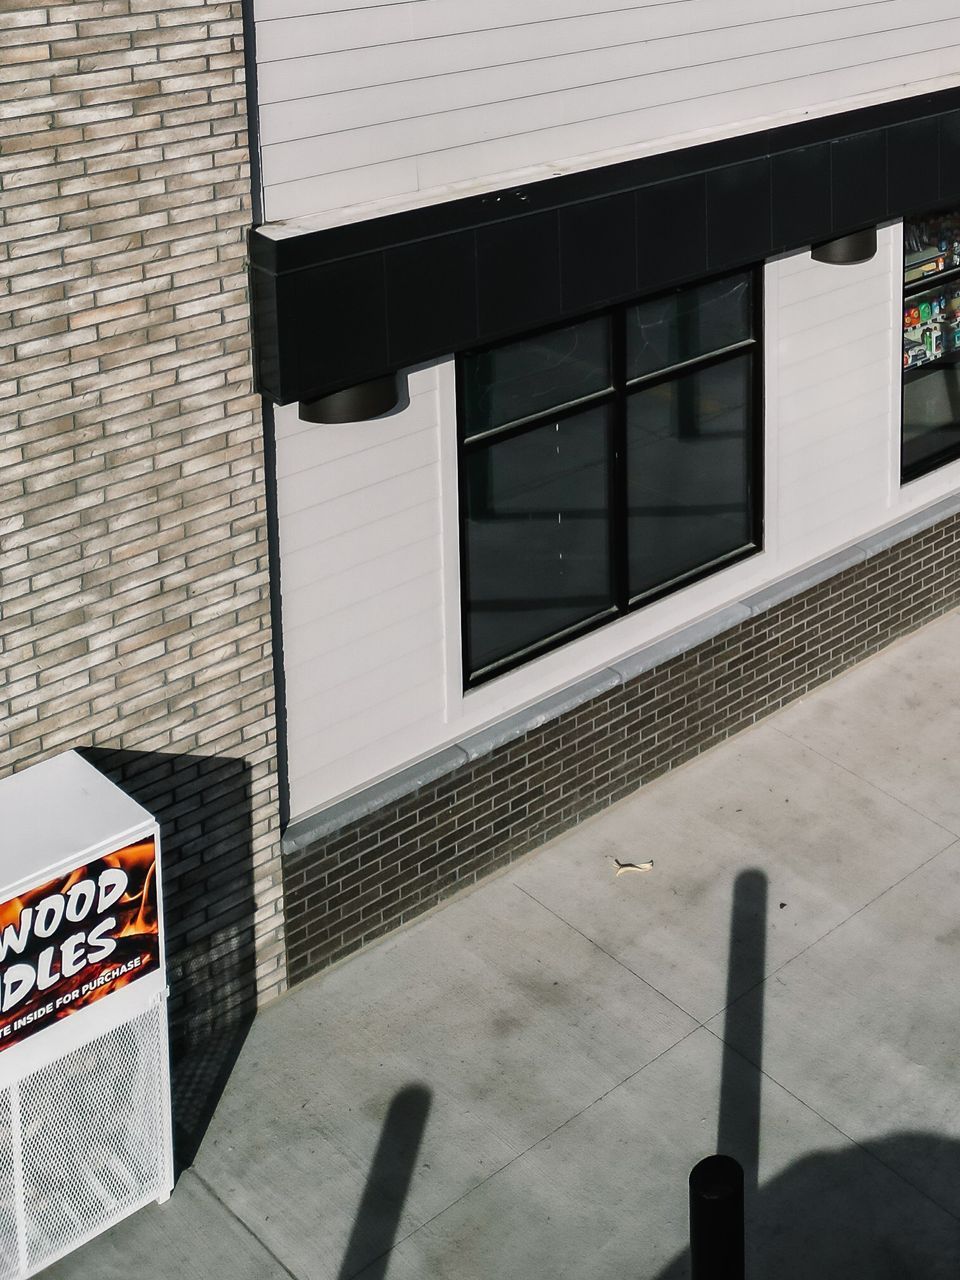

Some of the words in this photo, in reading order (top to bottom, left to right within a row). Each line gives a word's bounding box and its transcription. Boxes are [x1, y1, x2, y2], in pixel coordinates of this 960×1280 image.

[0, 869, 128, 963] WOOD
[0, 917, 117, 1014] DLES
[14, 1001, 53, 1031] INSIDE
[56, 987, 80, 1009] FOR
[82, 956, 141, 996] PURCHASE
